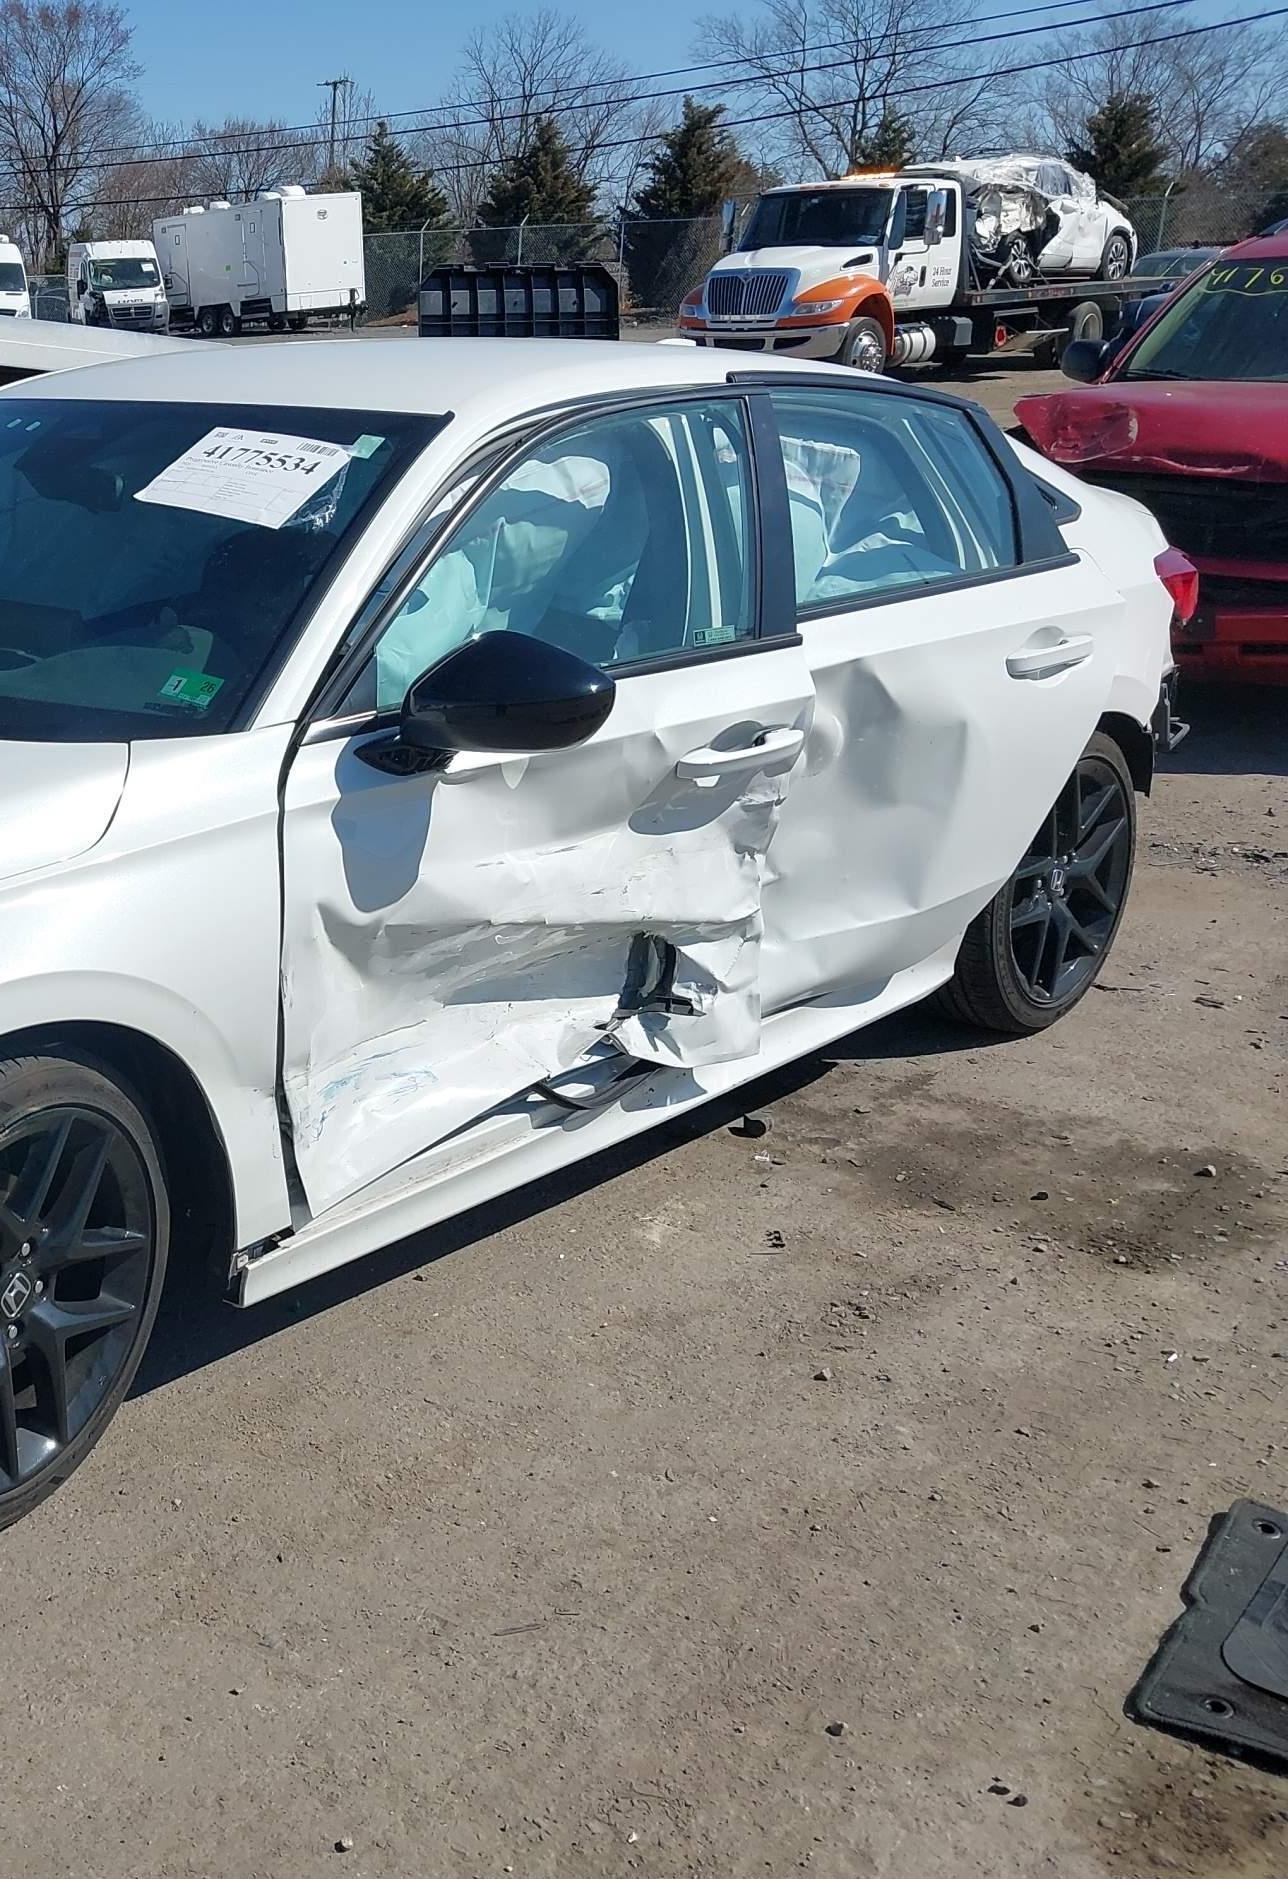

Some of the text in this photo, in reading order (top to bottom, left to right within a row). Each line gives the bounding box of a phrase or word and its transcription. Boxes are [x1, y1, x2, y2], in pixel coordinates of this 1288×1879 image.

[940, 266, 952, 276] Hour
[932, 279, 950, 288] Service
[203, 444, 321, 475] 41775534
